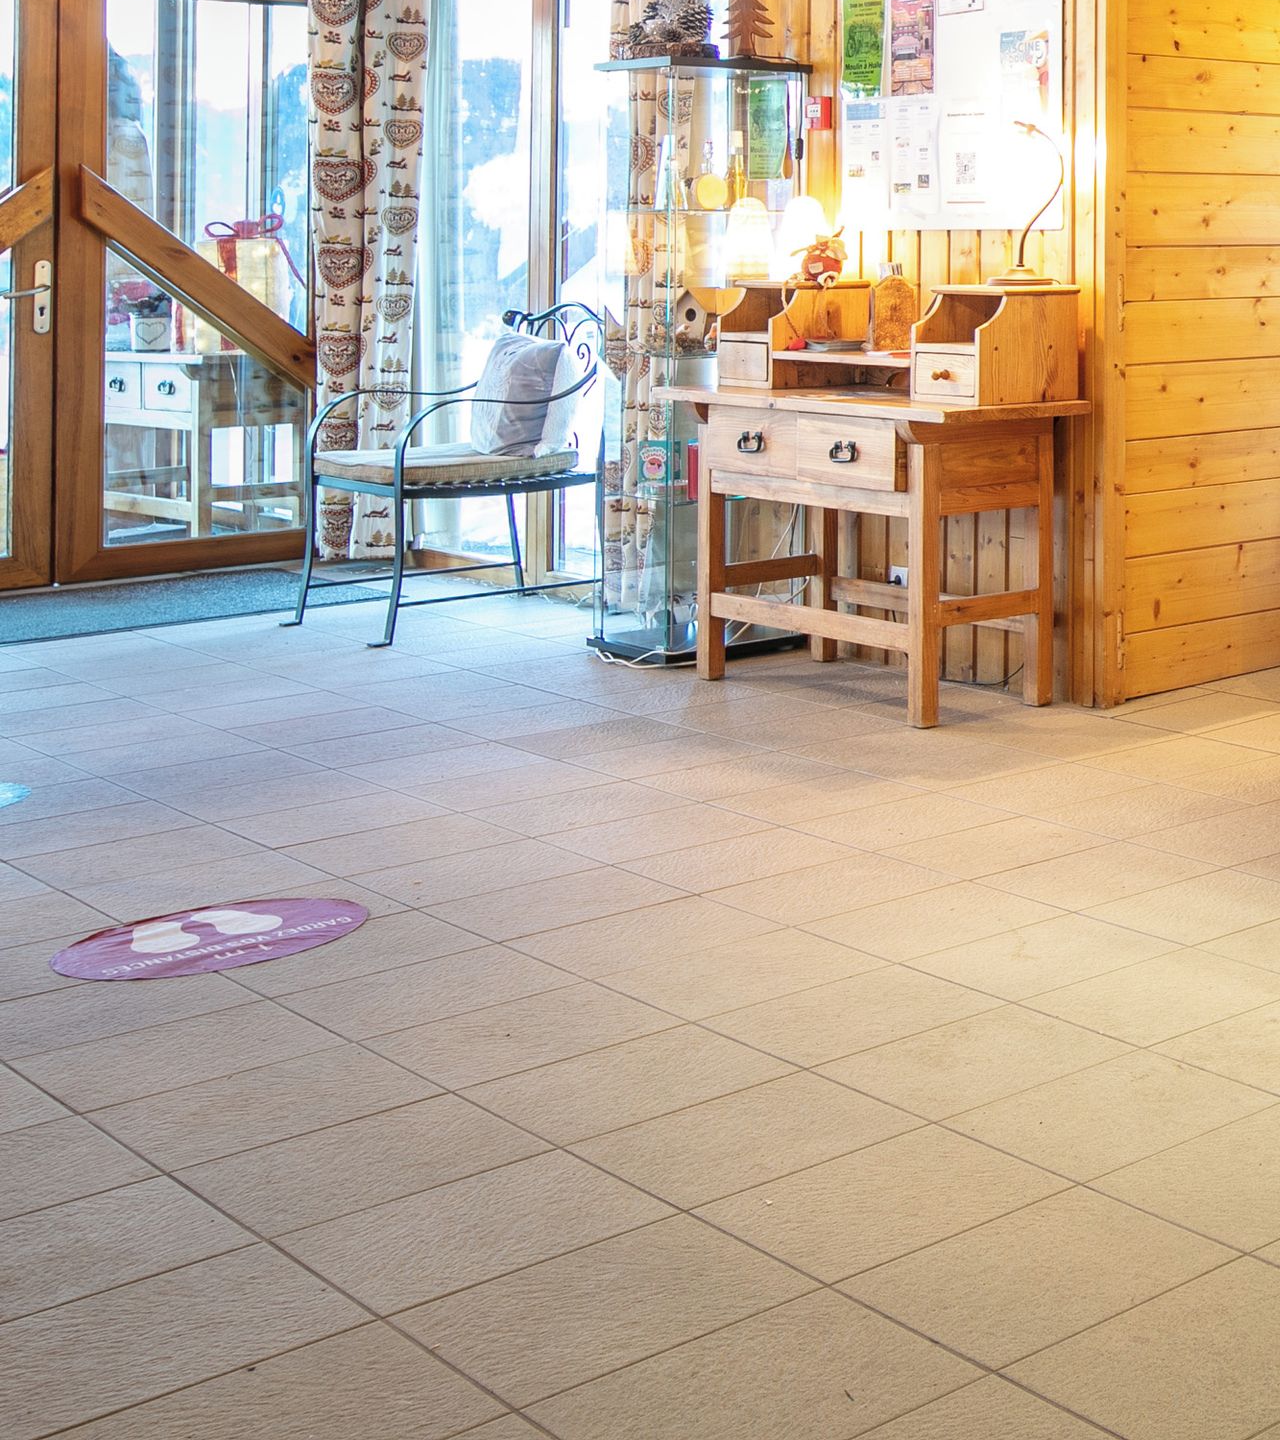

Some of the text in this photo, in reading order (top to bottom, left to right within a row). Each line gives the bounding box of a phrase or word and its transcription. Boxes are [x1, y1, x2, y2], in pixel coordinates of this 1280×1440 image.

[845, 60, 863, 71] Moulin
[101, 916, 352, 976] GARDEZ VOS DISTANCES
